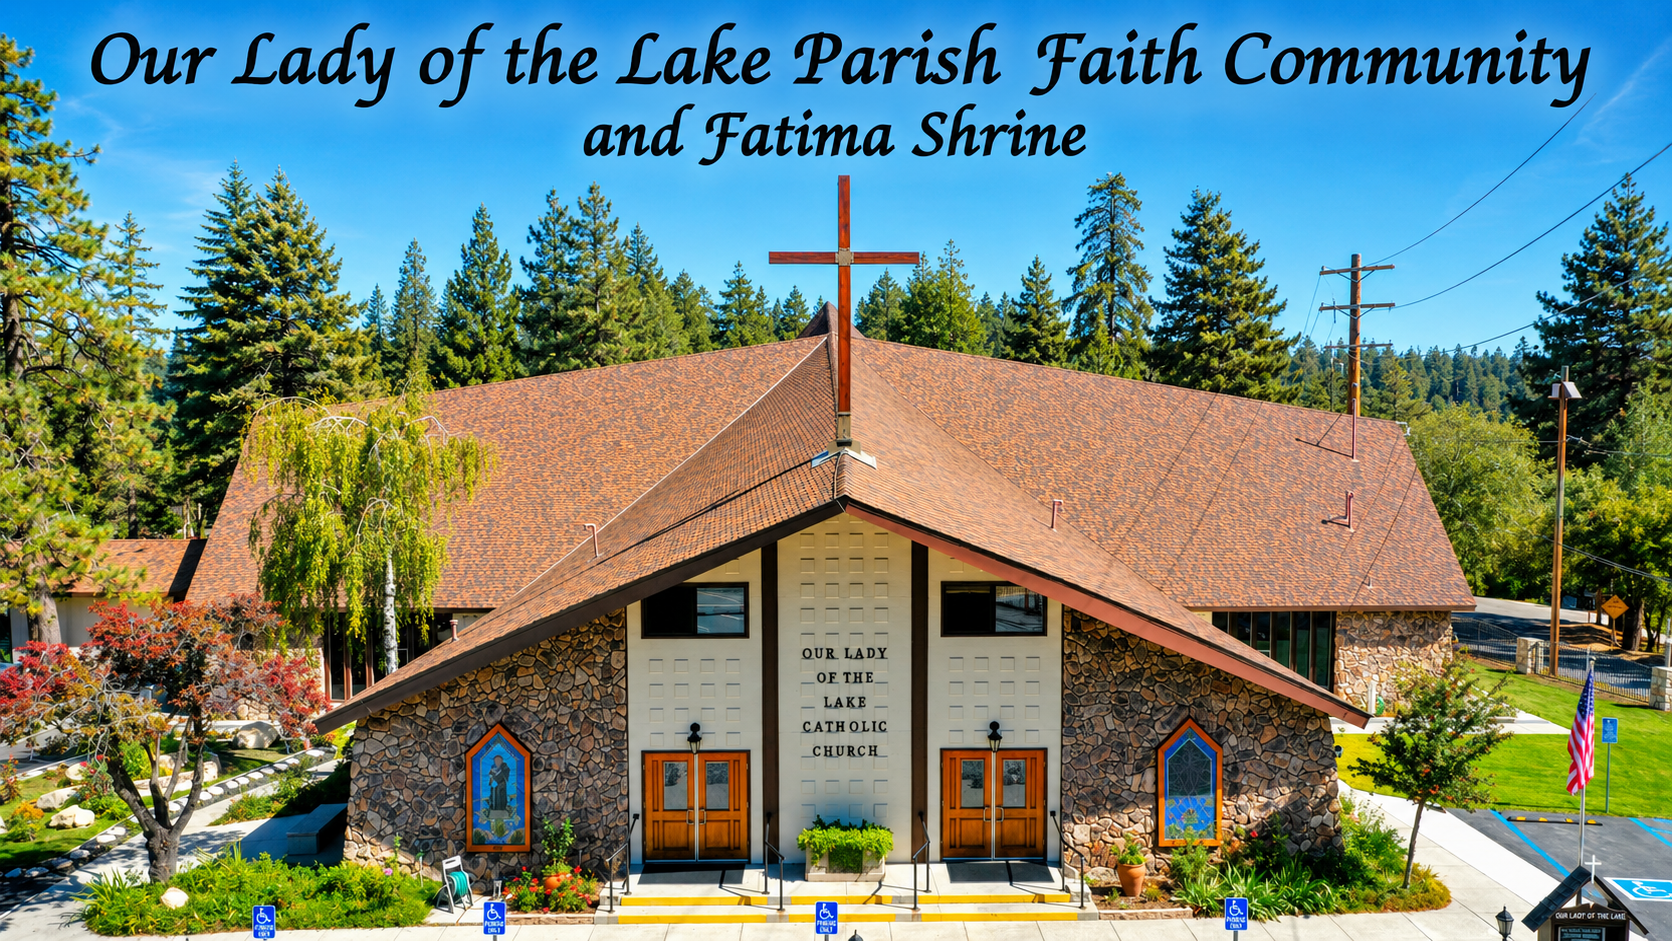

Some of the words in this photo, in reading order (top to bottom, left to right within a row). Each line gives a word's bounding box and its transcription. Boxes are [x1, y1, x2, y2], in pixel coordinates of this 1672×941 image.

[802, 647, 835, 660] OUR
[844, 647, 887, 660] LADY
[817, 672, 837, 684] OF
[843, 672, 874, 684] THE
[823, 696, 867, 708] LAKE
[802, 721, 887, 733] CATHOLIC
[812, 745, 878, 757] CHURCH
